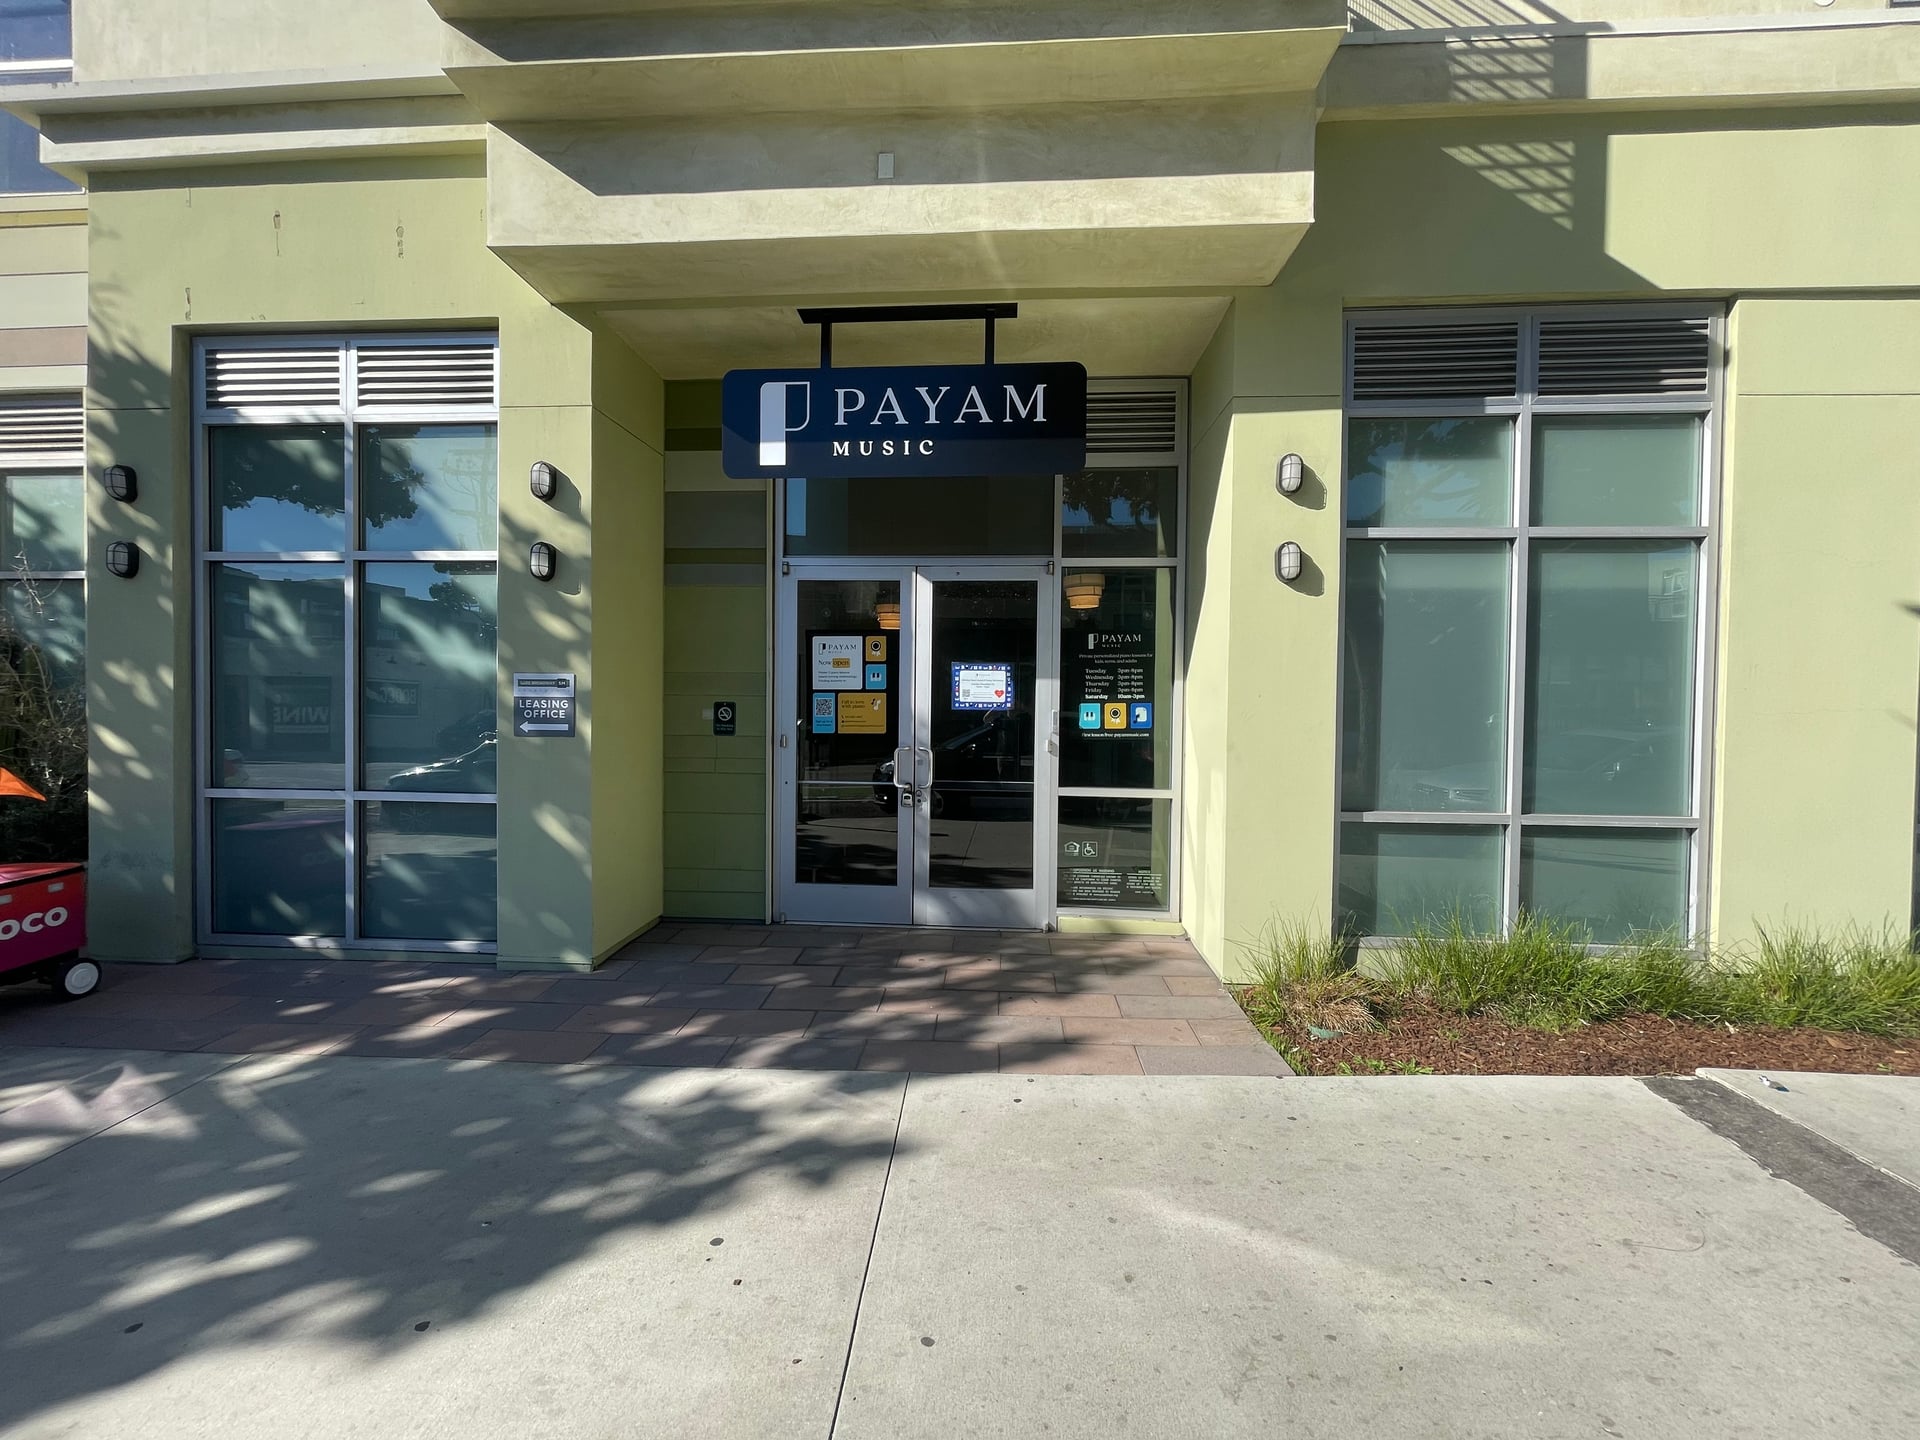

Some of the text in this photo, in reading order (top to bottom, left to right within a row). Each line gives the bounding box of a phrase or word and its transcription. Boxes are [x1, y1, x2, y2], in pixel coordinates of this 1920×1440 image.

[834, 384, 1048, 426] PAYAM
[832, 439, 935, 457] MUSIC
[1102, 633, 1142, 643] PAYAM
[828, 643, 857, 651] PAYAM
[519, 699, 569, 709] LEASING
[523, 709, 566, 719] OFFICE
